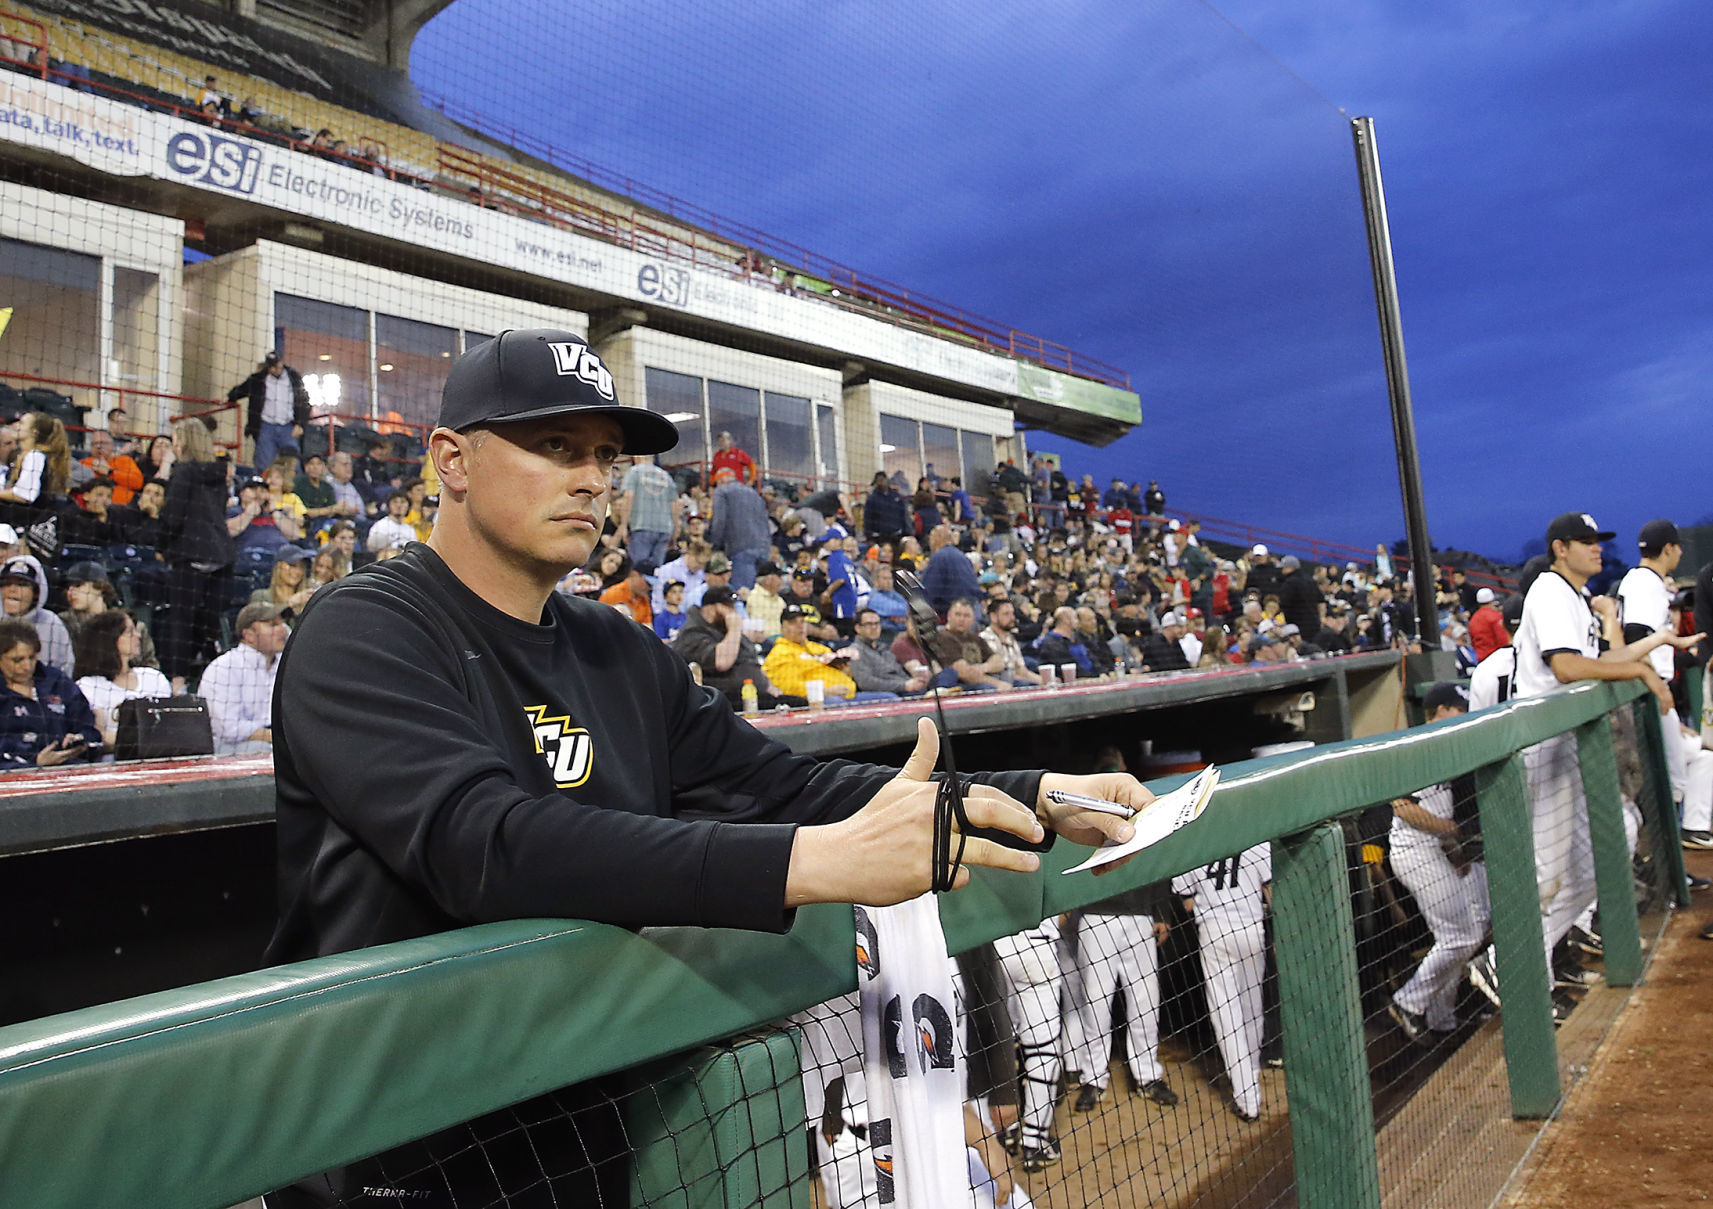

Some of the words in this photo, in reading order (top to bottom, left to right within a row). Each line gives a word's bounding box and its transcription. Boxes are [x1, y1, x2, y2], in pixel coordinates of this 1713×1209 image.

[268, 164, 381, 214] Electronic
[389, 199, 474, 239] Systems
[515, 238, 602, 273] www.esi.net
[548, 342, 615, 400] VCU
[523, 705, 594, 788] CU
[1206, 852, 1242, 891] 41
